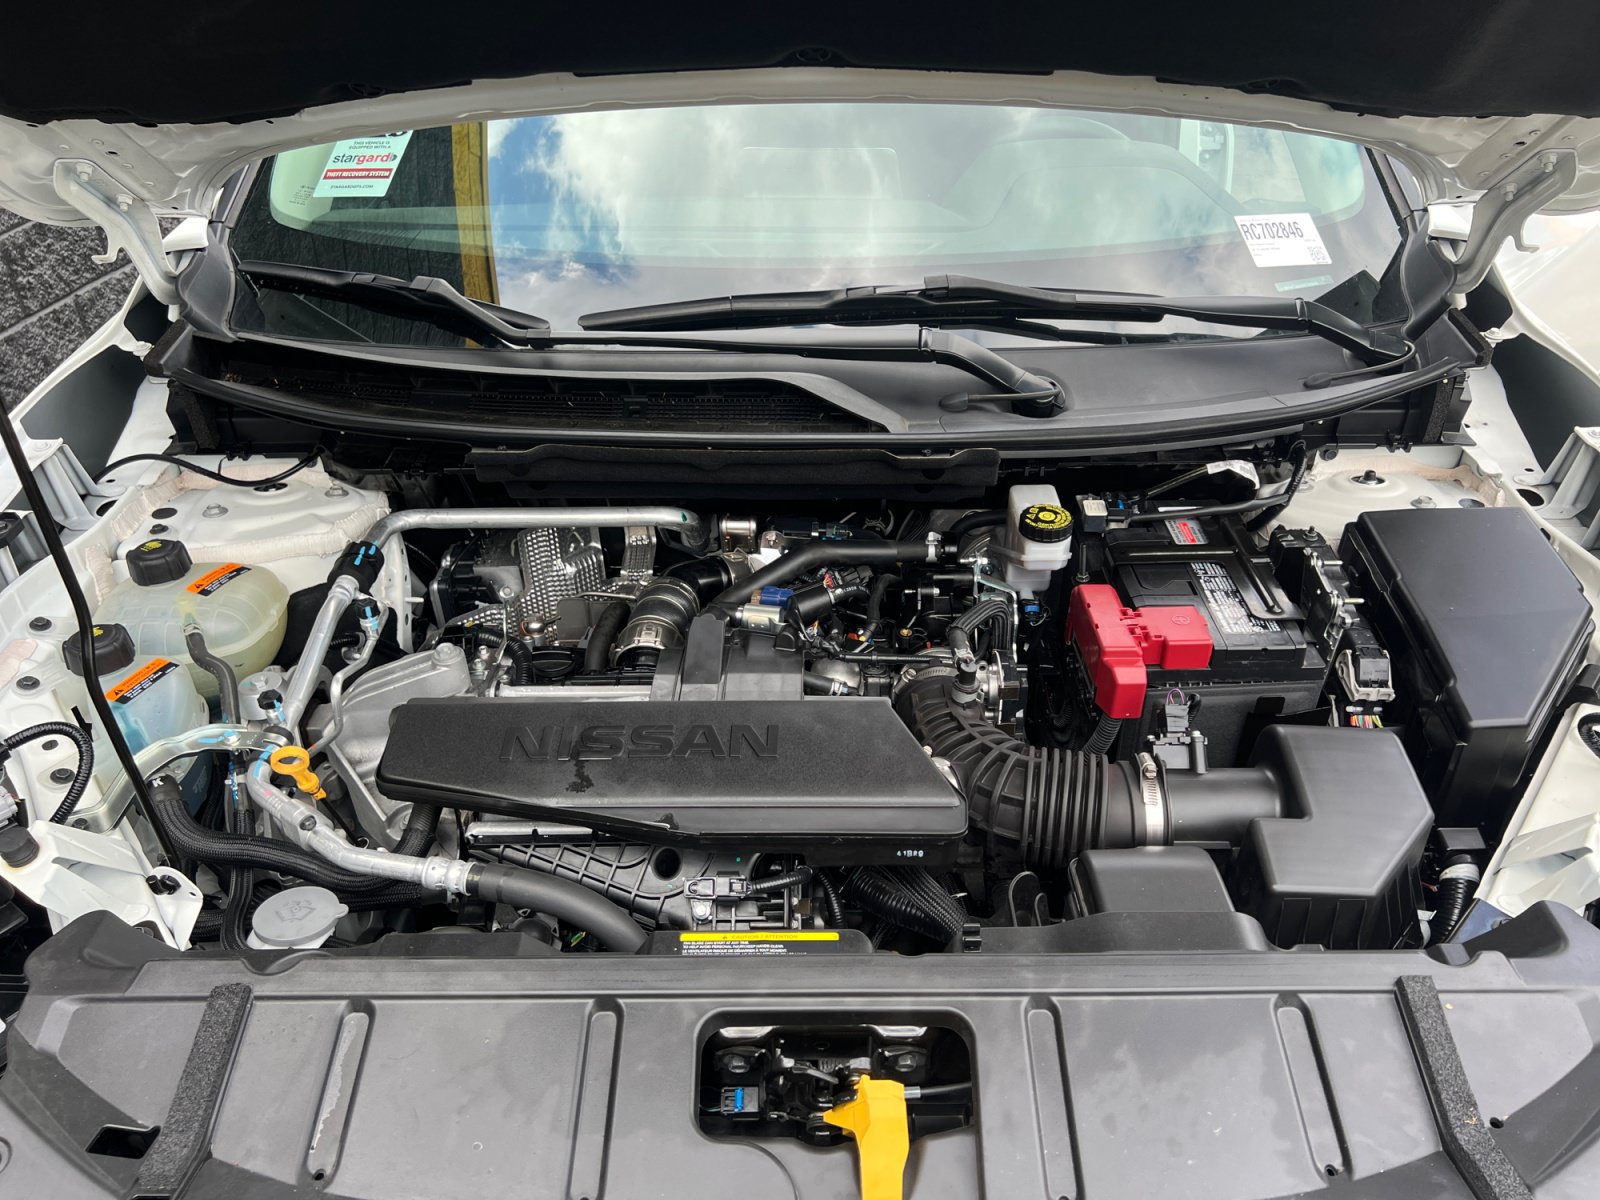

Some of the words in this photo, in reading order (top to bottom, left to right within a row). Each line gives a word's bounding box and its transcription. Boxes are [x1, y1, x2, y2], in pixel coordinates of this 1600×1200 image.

[332, 152, 391, 165] stargard
[1240, 221, 1304, 240] RC702846
[499, 724, 779, 760] NISSAN
